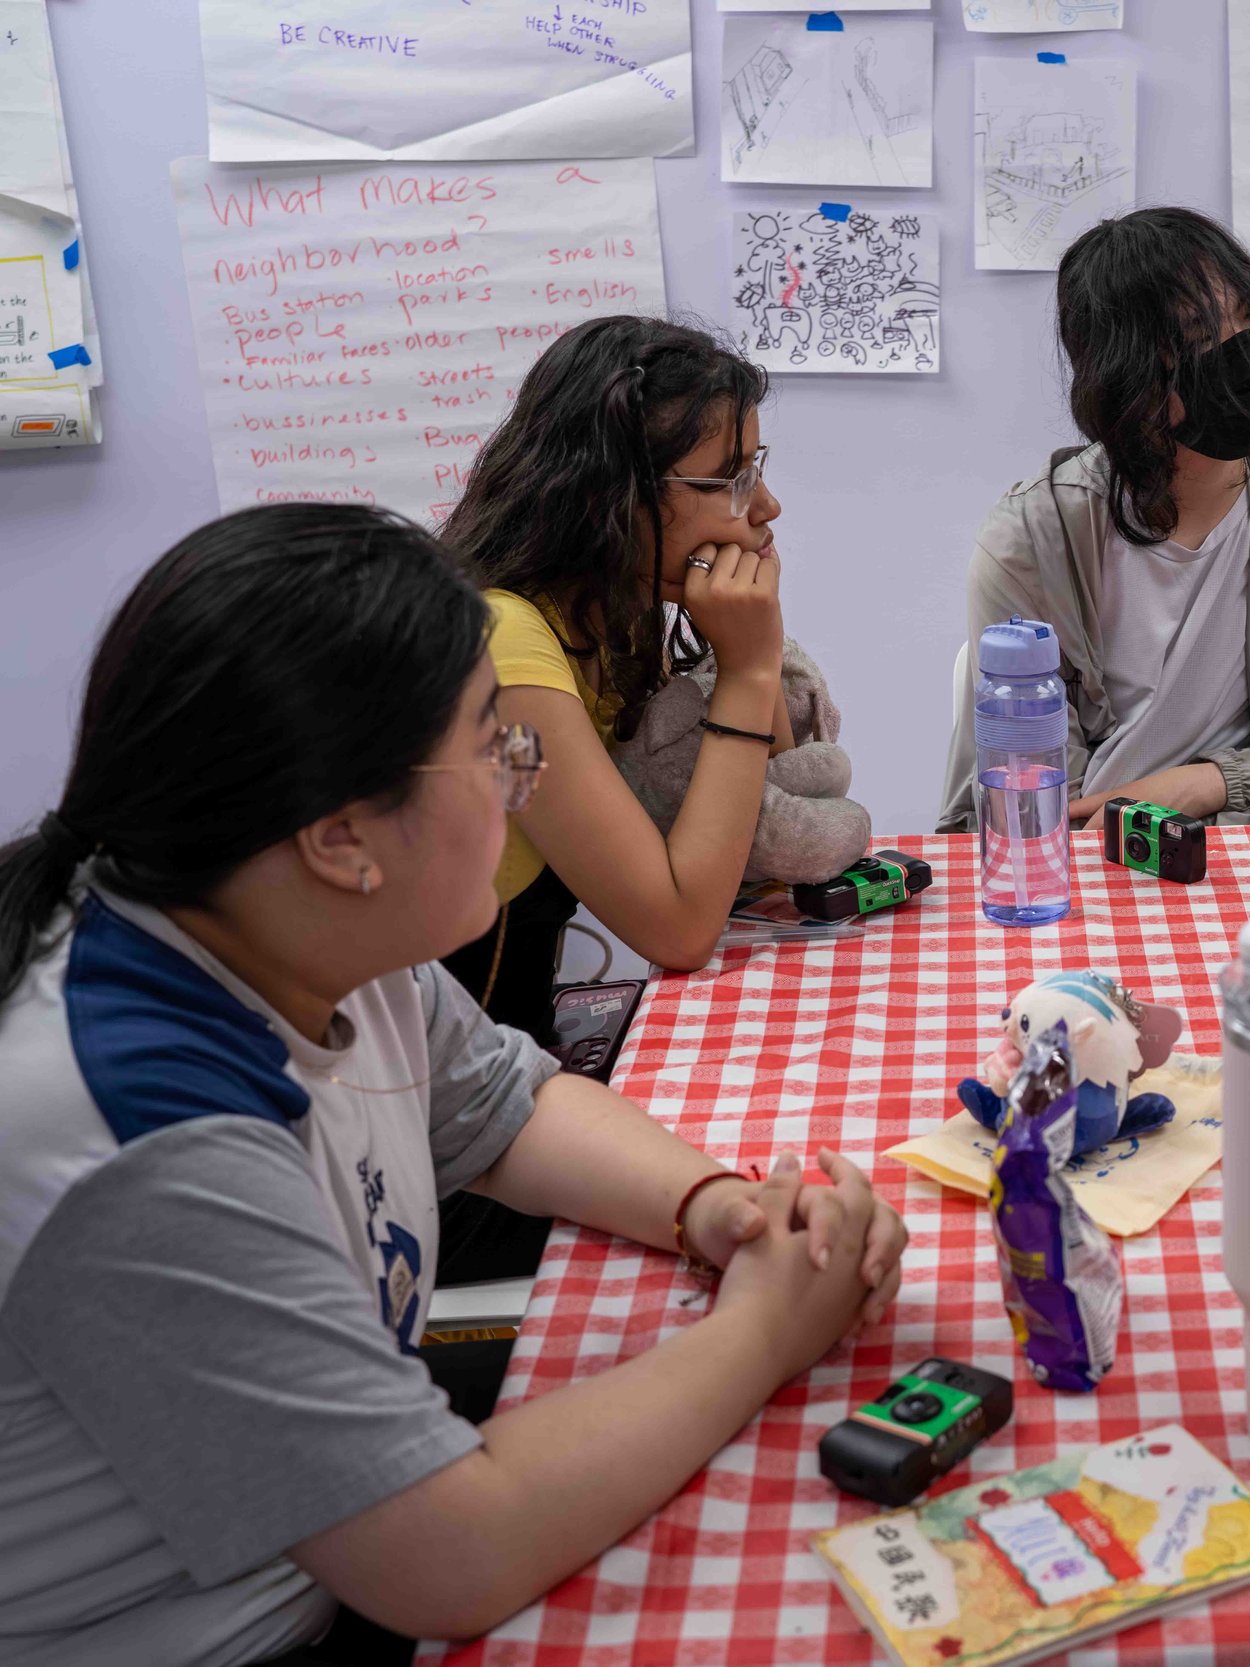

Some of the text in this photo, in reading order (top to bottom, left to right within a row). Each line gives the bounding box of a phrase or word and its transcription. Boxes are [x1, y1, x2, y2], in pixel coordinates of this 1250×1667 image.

[526, 16, 616, 48] HELP OTHER
[571, 14, 603, 30] EACH
[279, 23, 419, 57] BE CREATIVE
[547, 37, 677, 100] WHEN STRUGGLING
[204, 175, 326, 227] What
[556, 167, 602, 184] a
[548, 238, 636, 265] smells
[395, 263, 489, 290] location
[397, 286, 492, 326] parks
[545, 278, 638, 307] English
[221, 292, 365, 326] Bus station
[234, 314, 347, 360] people
[404, 331, 469, 351] older
[417, 362, 495, 387] streets
[431, 387, 493, 408] trash
[250, 442, 377, 469] buildings
